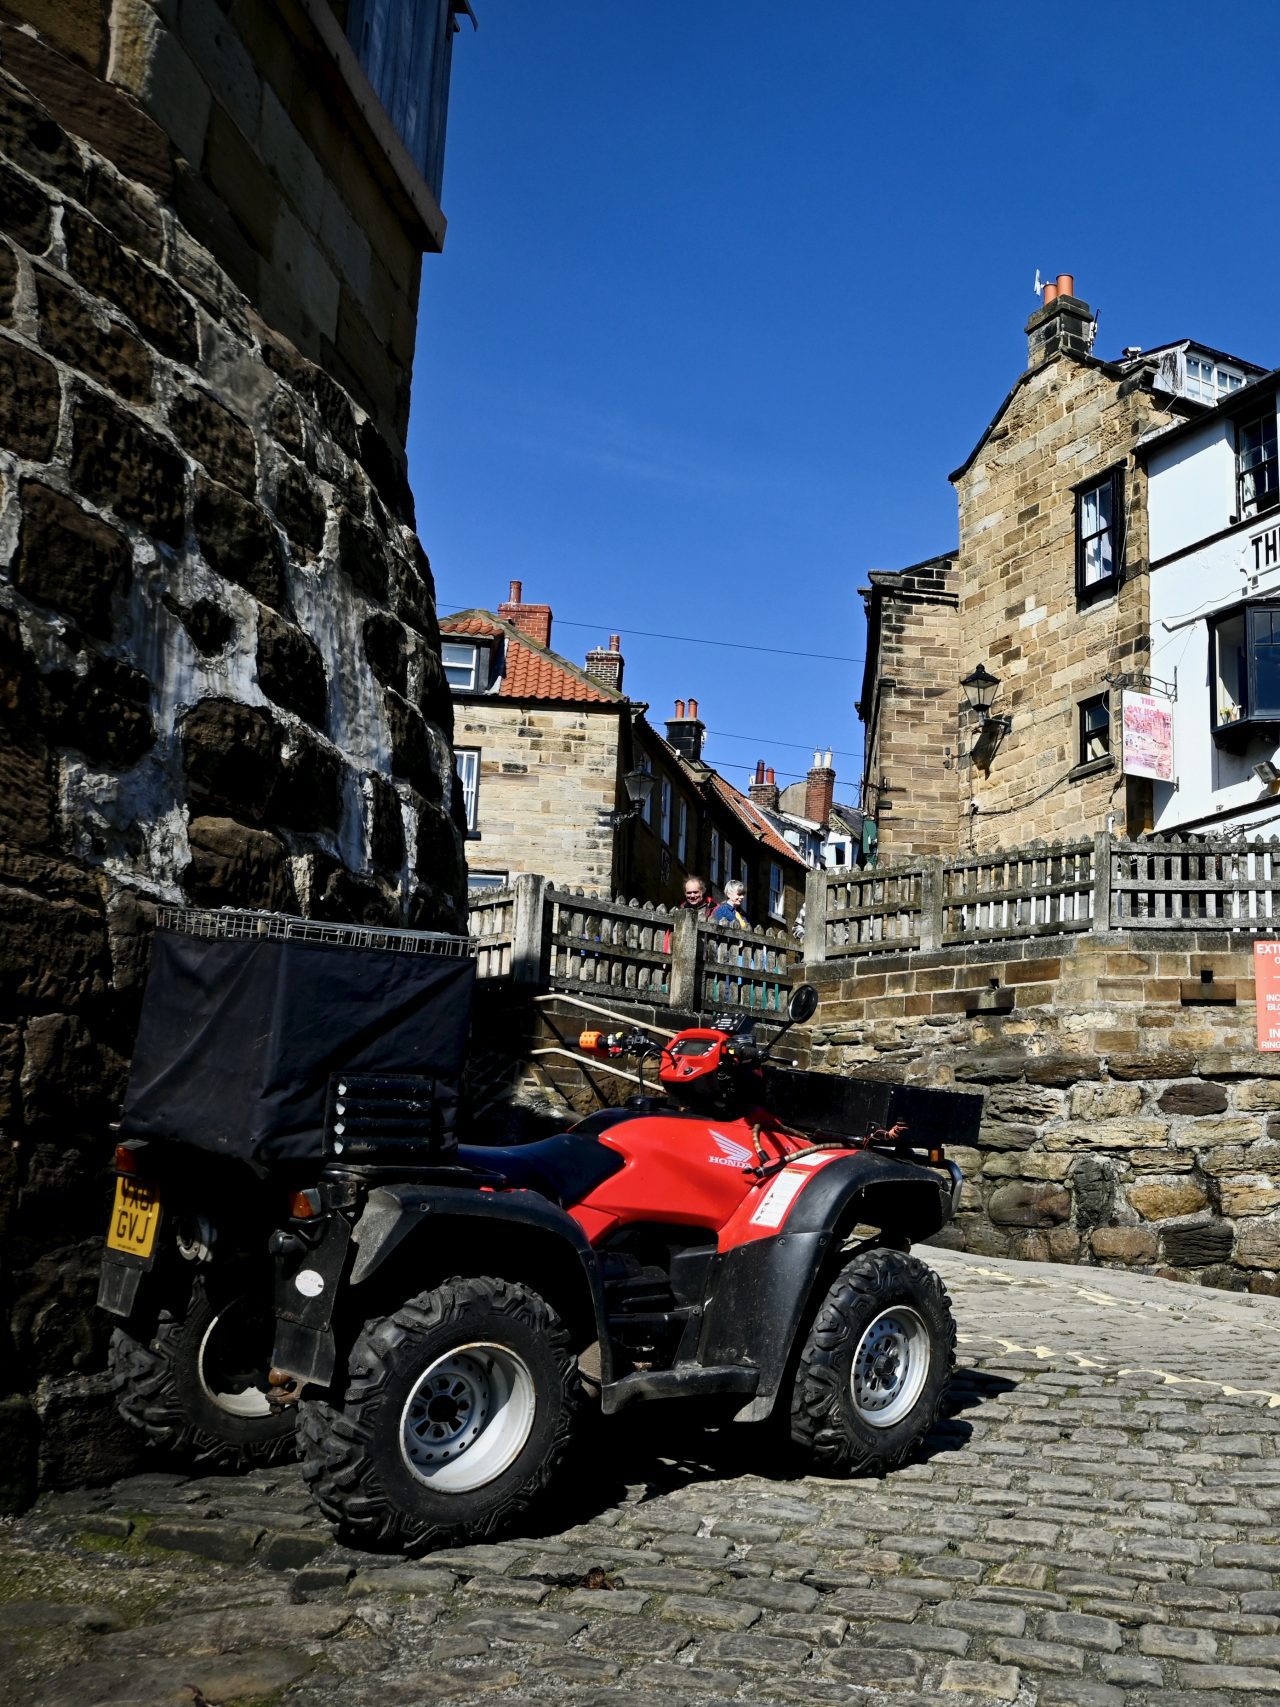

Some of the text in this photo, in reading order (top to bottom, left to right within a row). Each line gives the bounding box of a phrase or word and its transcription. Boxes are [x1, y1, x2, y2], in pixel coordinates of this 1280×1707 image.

[1141, 697, 1155, 707] THE
[1269, 1028, 1280, 1038] IN
[708, 1155, 753, 1169] HONDA
[116, 1210, 151, 1243] GVJ
